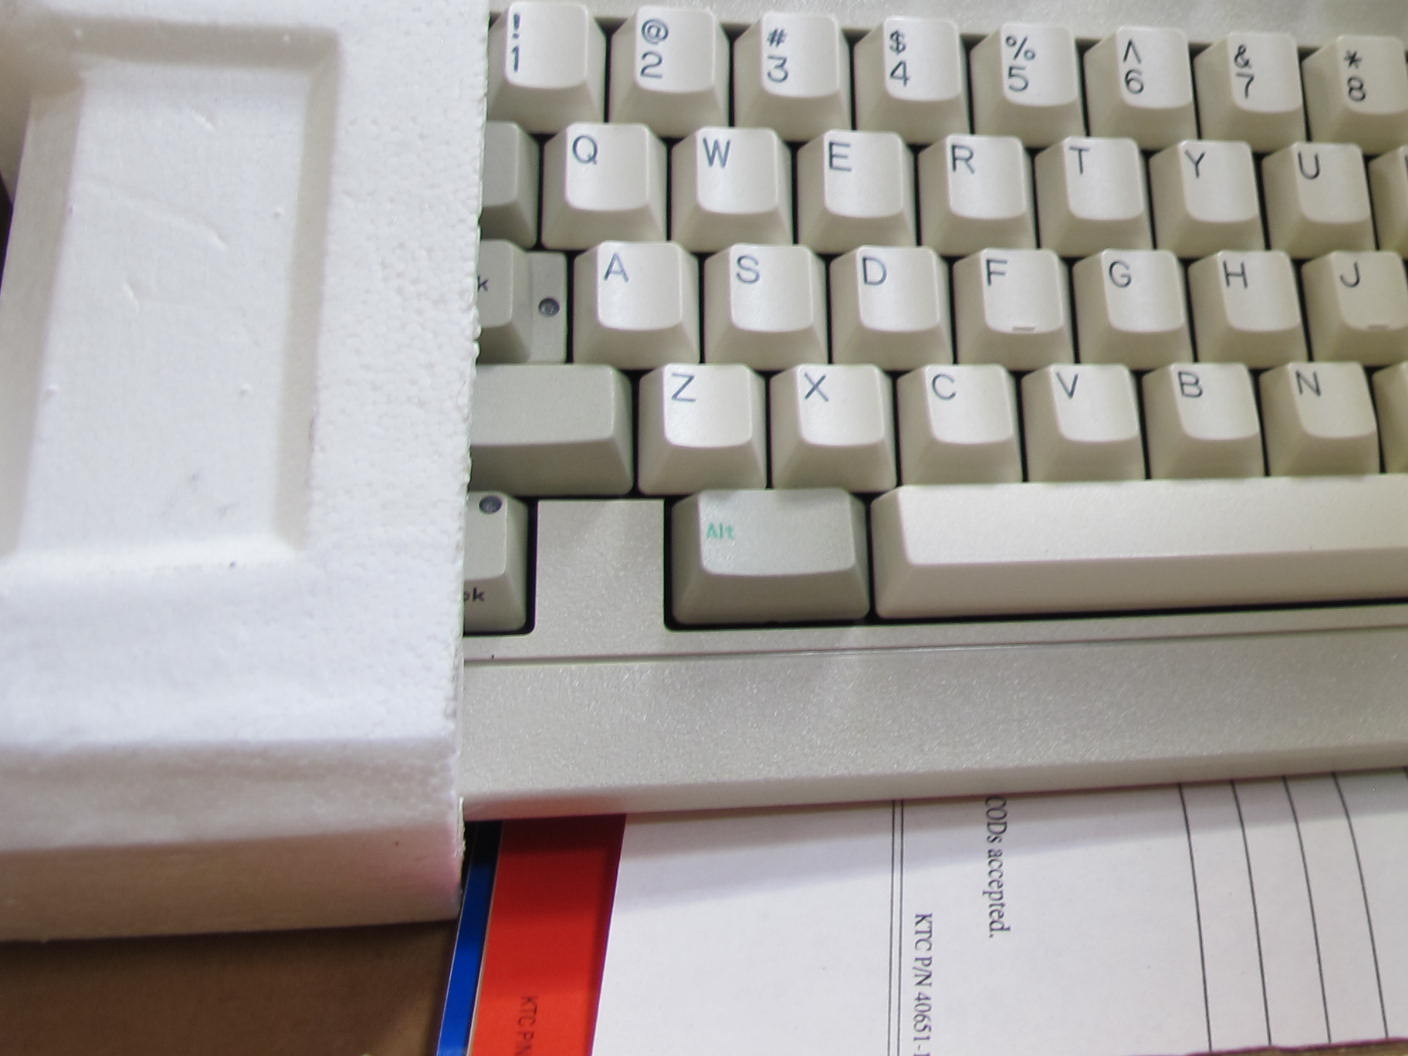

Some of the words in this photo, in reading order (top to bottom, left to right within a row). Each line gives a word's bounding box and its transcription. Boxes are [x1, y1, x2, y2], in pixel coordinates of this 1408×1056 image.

[511, 45, 521, 73] 1
[640, 51, 664, 79] 2
[767, 54, 790, 84] 3
[889, 60, 911, 87] 4
[1007, 66, 1030, 92] 5
[1123, 69, 1145, 95] 6
[1235, 72, 1255, 99] 7
[1347, 76, 1367, 102] 8
[572, 135, 599, 165] Q
[703, 137, 731, 169] W
[828, 141, 852, 172] E
[951, 145, 975, 174] R
[1069, 145, 1091, 175] T
[1184, 150, 1206, 178] Y
[1297, 152, 1320, 180] U
[603, 252, 630, 283] A
[735, 254, 761, 284] S
[862, 256, 888, 286] D
[986, 259, 1009, 287] F
[1108, 260, 1133, 289] G
[1223, 261, 1248, 289] H
[1340, 262, 1361, 288] J
[671, 372, 697, 403] Z
[804, 372, 830, 402] X
[931, 374, 957, 401] C
[1056, 372, 1080, 399] V
[1178, 371, 1203, 398] B
[1295, 370, 1321, 396] N
[706, 522, 736, 540] Alt
[985, 796, 1008, 844] CODs
[982, 849, 1011, 938] accepted.
[915, 912, 933, 951] KTC
[912, 957, 933, 987] P/N
[518, 995, 538, 1025] KTC
